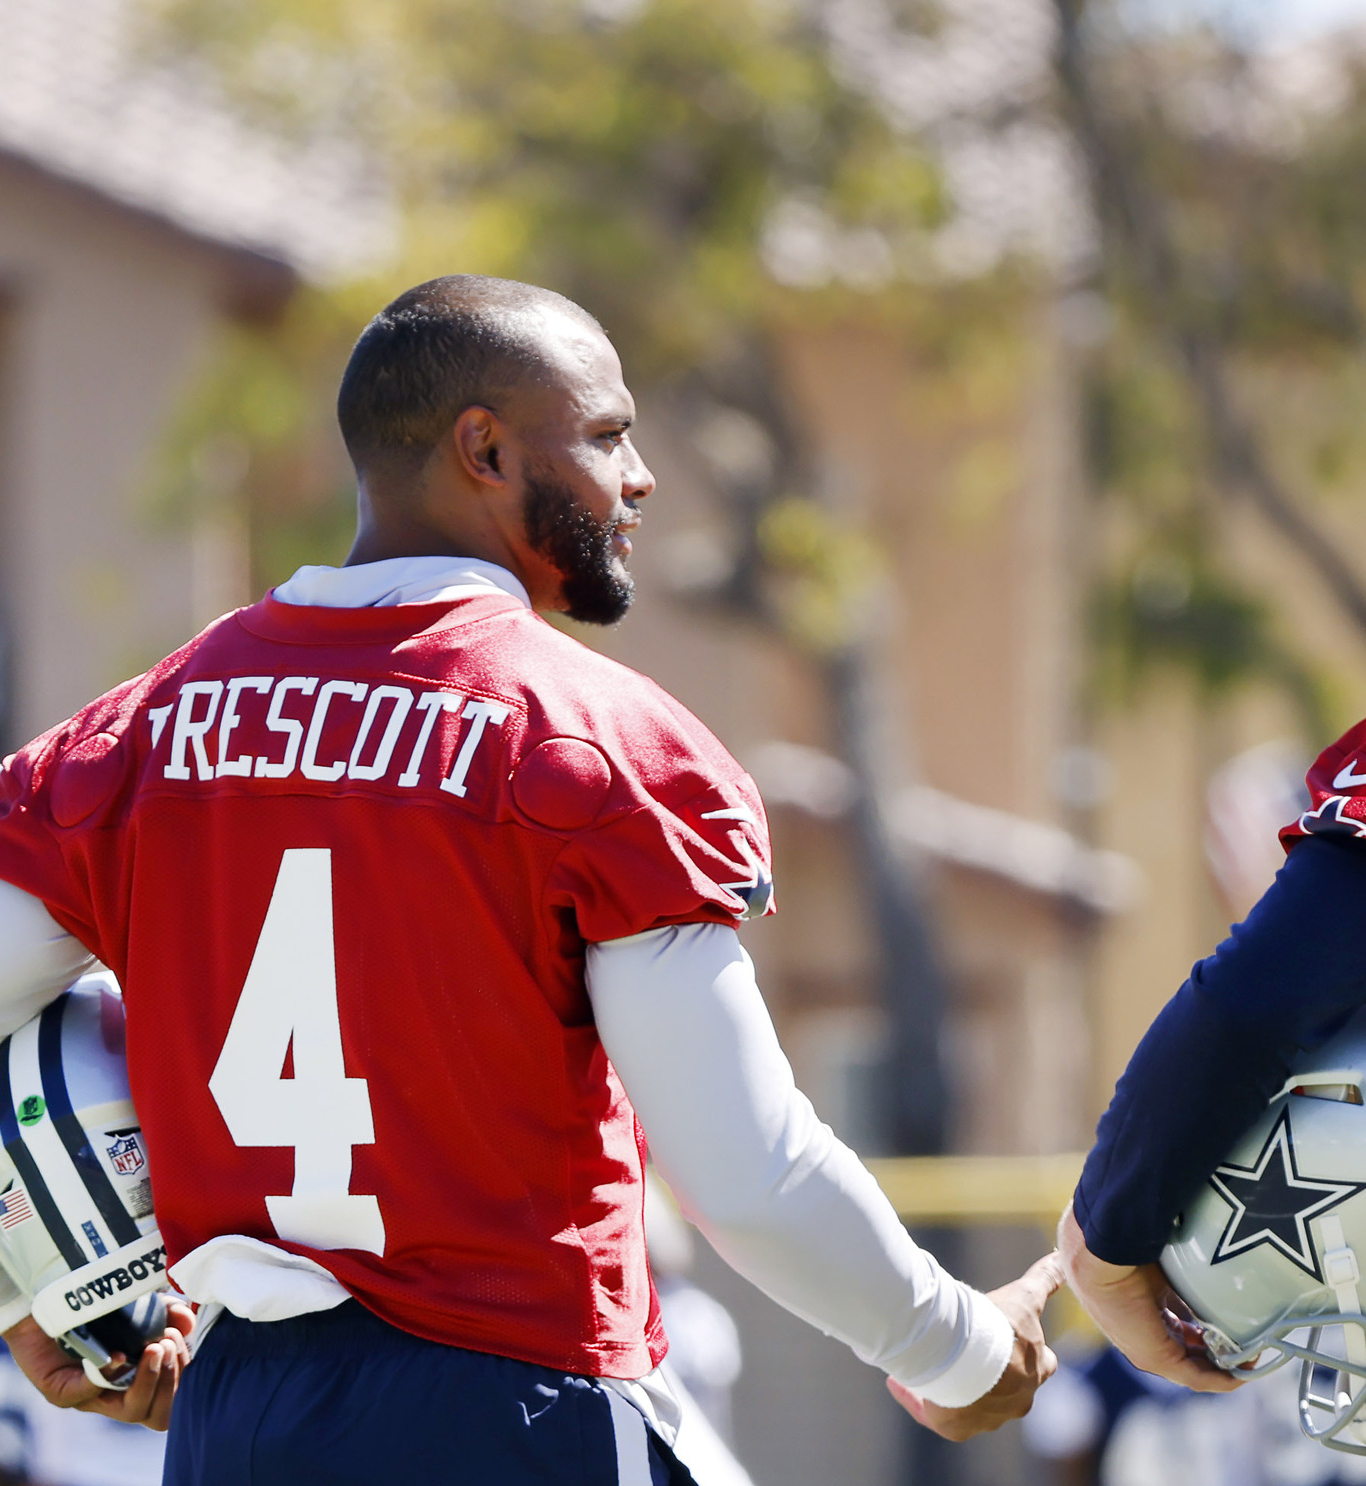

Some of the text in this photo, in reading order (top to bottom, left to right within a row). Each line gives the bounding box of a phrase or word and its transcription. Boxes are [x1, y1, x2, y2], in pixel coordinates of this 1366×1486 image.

[148, 676, 509, 798] RESCOTT
[208, 848, 385, 1258] 4
[114, 1150, 142, 1171] NFL
[64, 1244, 167, 1311] COWBOY
